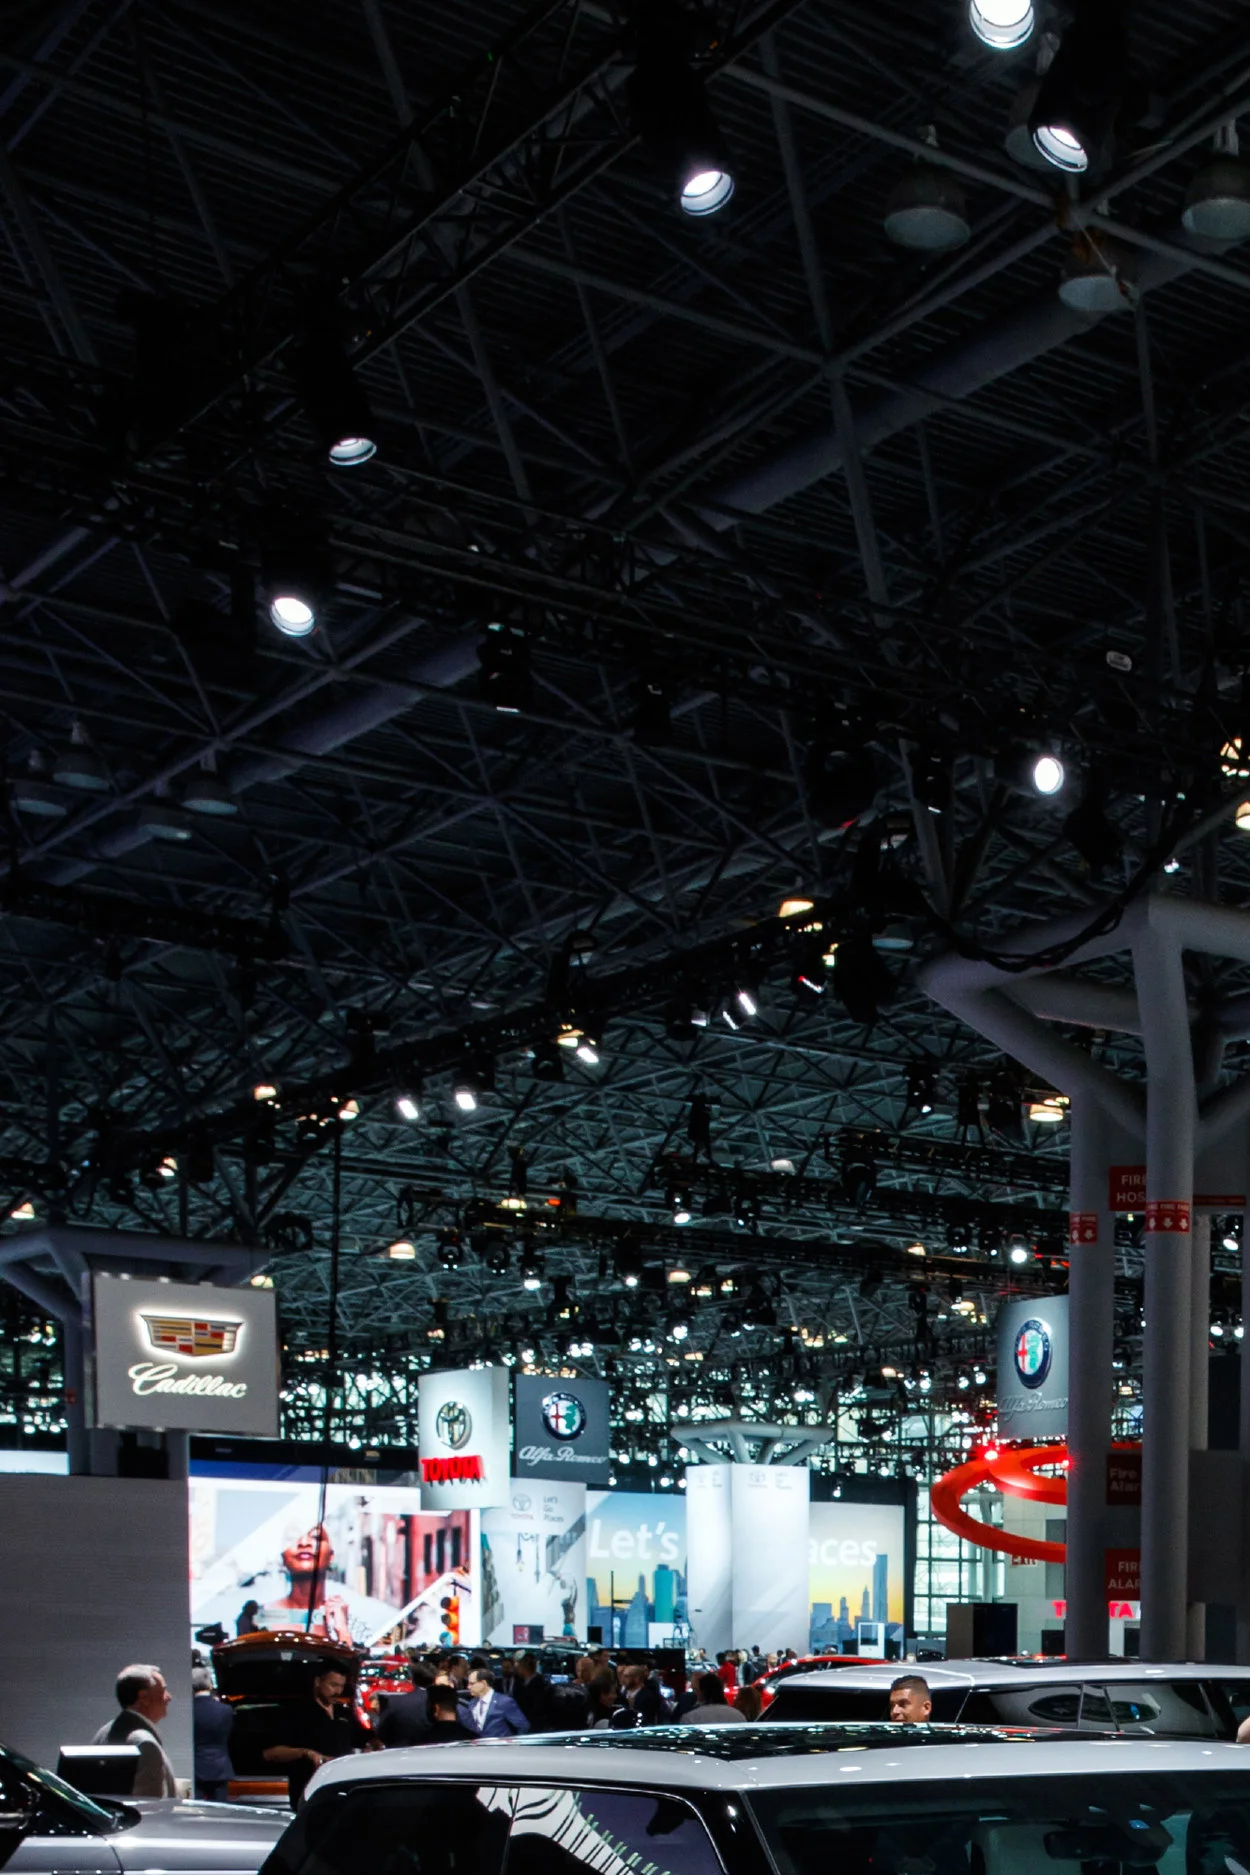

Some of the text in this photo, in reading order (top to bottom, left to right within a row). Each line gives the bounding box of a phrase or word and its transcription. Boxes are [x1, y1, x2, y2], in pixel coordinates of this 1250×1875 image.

[1116, 1191, 1147, 1203] HOS
[128, 1362, 248, 1398] Cadillac
[518, 1445, 608, 1466] Alfa Romeo
[420, 1454, 482, 1483] TOYOTA
[1110, 1480, 1141, 1492] Alar
[588, 1519, 878, 1567] Let's aces
[1118, 1561, 1141, 1572] FIR
[1108, 1579, 1141, 1589] ALAR
